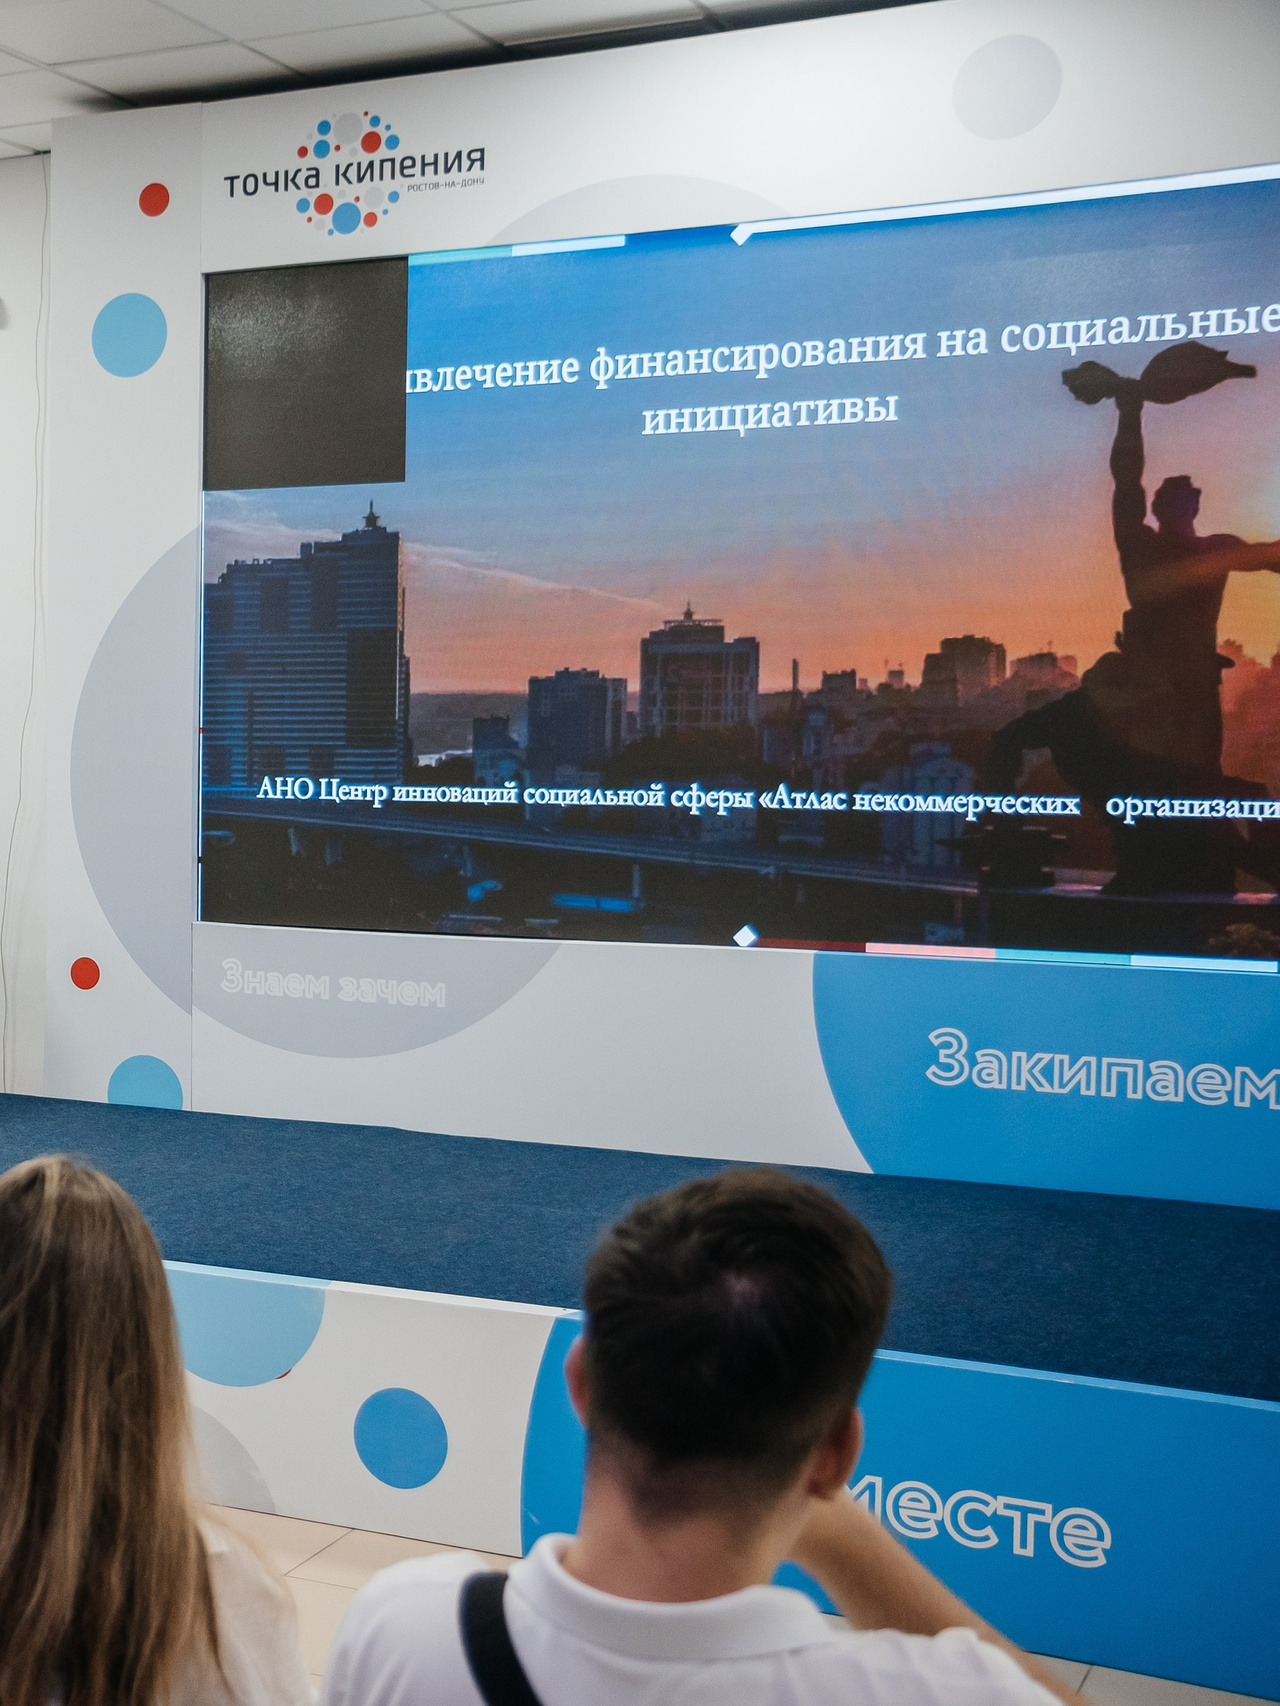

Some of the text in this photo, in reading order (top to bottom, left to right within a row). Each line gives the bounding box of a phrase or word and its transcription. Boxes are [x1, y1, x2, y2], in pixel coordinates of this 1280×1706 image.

[223, 147, 485, 198] точка кипения
[407, 177, 485, 193] РОСТОВ-НА-ДОНУ
[405, 303, 1280, 393] влечение финансирования на социальные
[641, 395, 899, 438] инициативы
[256, 775, 314, 800] АНО
[318, 778, 388, 808] Центр
[391, 780, 518, 806] инноваций
[523, 782, 665, 807] социальной
[670, 783, 754, 816] сферы
[758, 782, 847, 811] «Атлас
[851, 793, 1081, 822] некоммерческих
[220, 957, 447, 1009] Знаем зачем
[925, 1027, 1280, 1110] Закипаем
